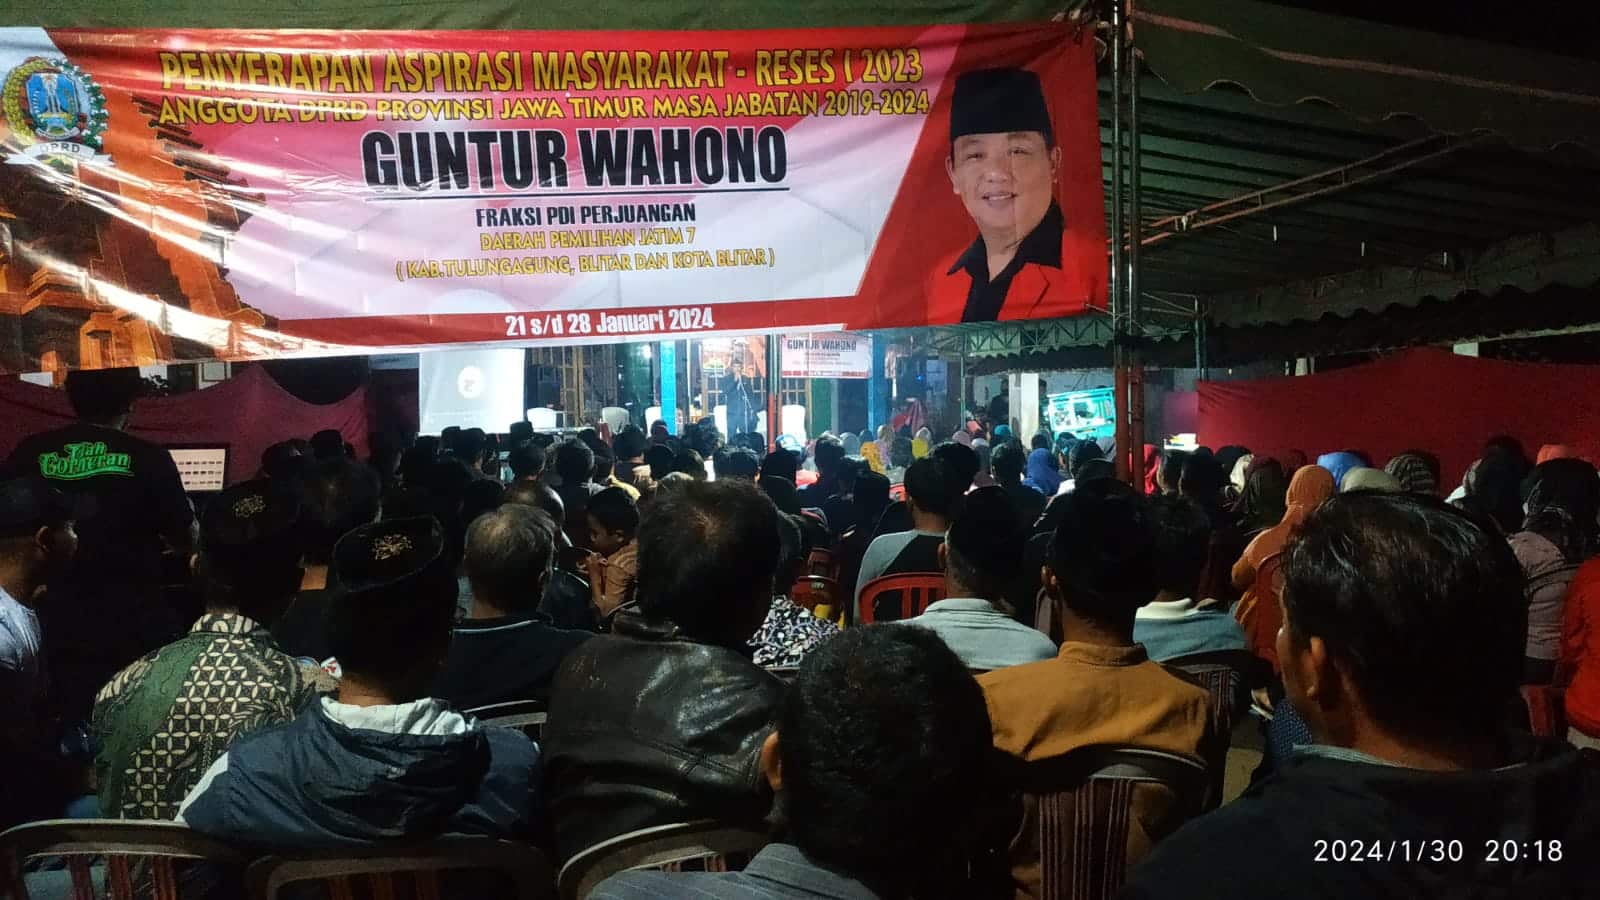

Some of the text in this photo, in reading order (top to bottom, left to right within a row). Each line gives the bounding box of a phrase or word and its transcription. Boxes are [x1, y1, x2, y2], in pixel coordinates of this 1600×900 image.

[159, 51, 374, 93] PENYERAPAN
[384, 50, 523, 92] ASPIRASI
[532, 50, 729, 91] MASYARAKAT
[756, 50, 835, 87] RESES
[862, 48, 924, 83] 2023
[159, 88, 929, 124] ANGGOTA DPRD PROVINSI JAWA TIMUR MASA JABATAN 2019-2024
[40, 142, 80, 153] DPRD
[361, 126, 788, 191] GUNTUR WAHONO
[476, 203, 696, 227] FRAKSI PDI PERJUANGAN
[480, 226, 696, 250] DAERAH PEMILIHAN JATIM 7
[579, 253, 632, 272] BLITAR
[635, 253, 669, 271] DAN
[672, 251, 714, 269] KOTA
[716, 248, 767, 267] BLITAR
[505, 307, 715, 336] 21 s/d 28 Januari 2024
[821, 339, 857, 351] WAHONO
